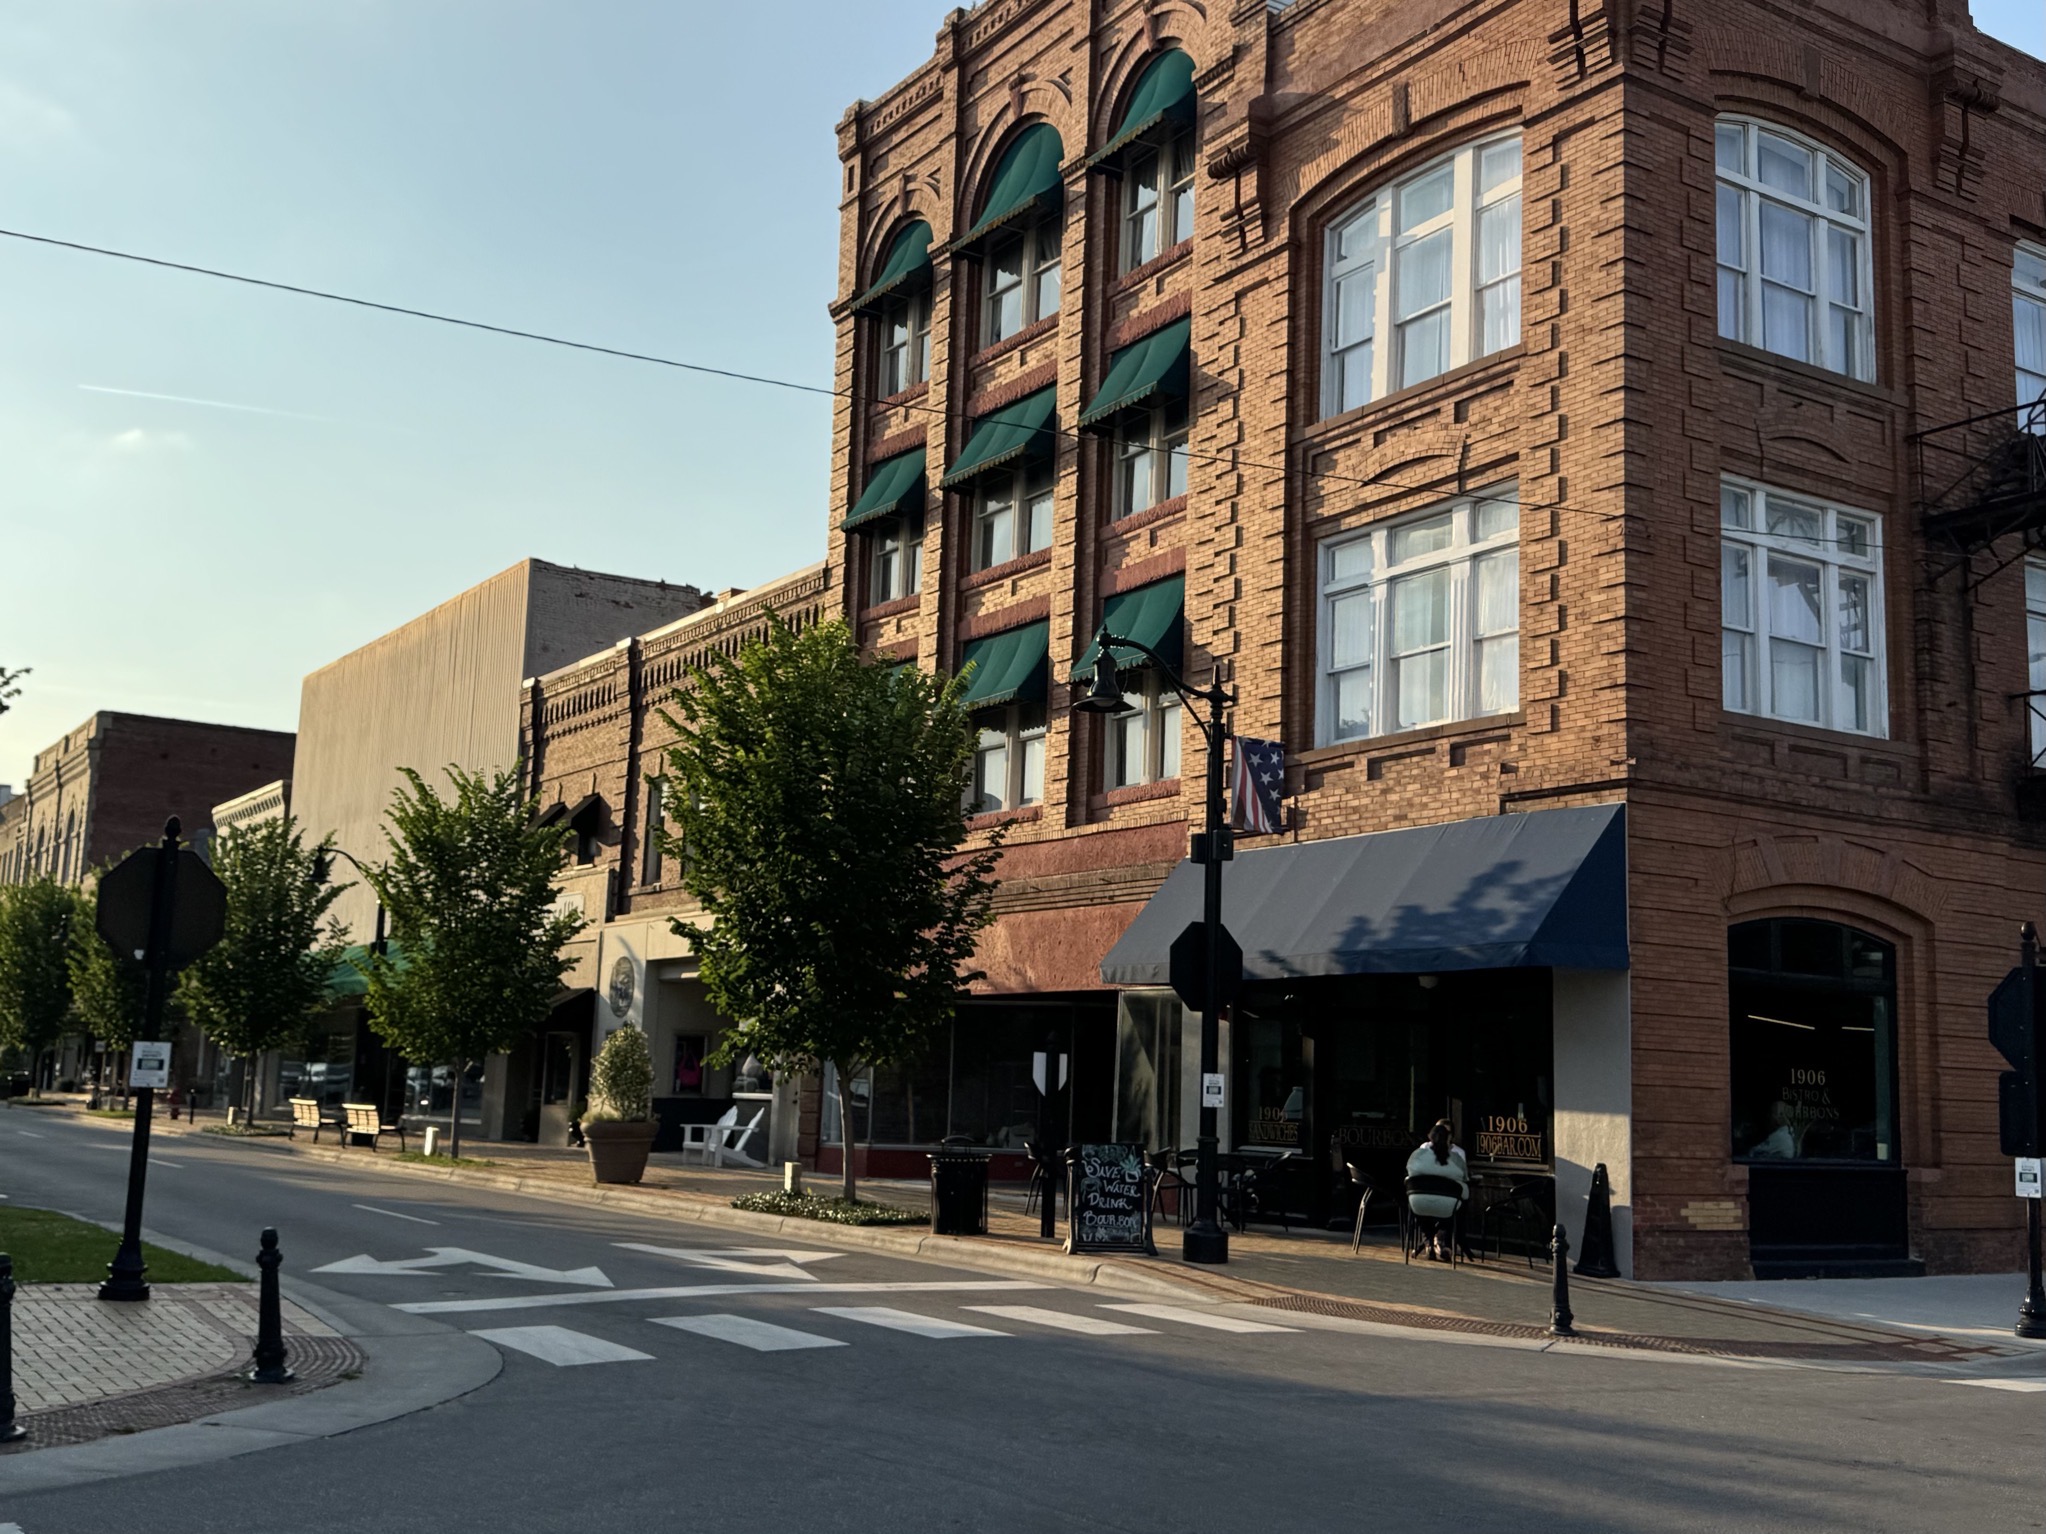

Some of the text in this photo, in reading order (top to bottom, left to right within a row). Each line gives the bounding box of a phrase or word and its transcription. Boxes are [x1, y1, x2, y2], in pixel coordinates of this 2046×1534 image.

[1791, 1067, 1826, 1085] 1906
[1821, 1087, 1831, 1105] &
[1488, 1115, 1528, 1133] 1906
[1087, 1192, 1133, 1210] DRINK
